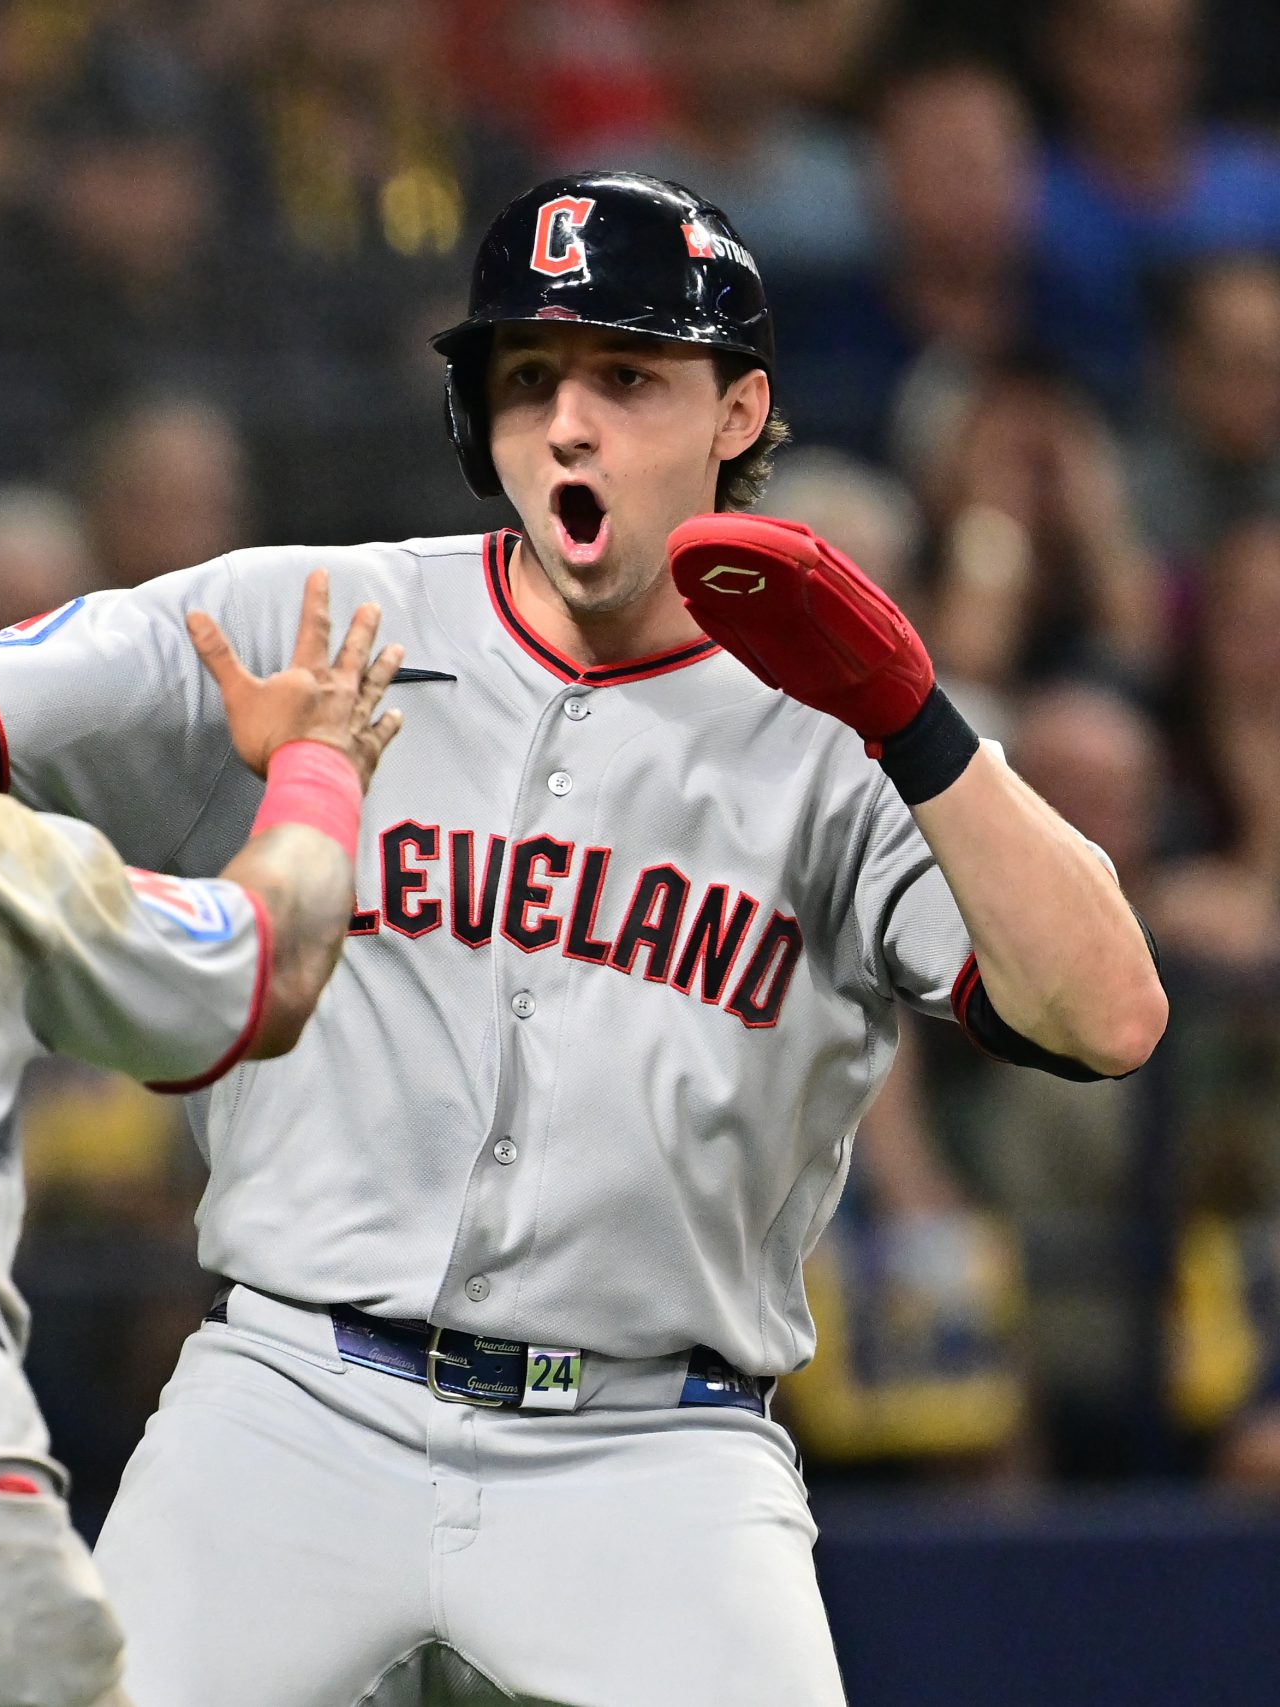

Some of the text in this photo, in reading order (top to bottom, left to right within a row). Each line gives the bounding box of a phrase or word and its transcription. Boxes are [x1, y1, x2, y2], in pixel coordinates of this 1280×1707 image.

[530, 195, 596, 277] C
[346, 818, 804, 1029] EVELAND
[473, 1336, 521, 1353] Guardian
[467, 1375, 519, 1394] Guardians
[531, 1354, 574, 1393] 24
